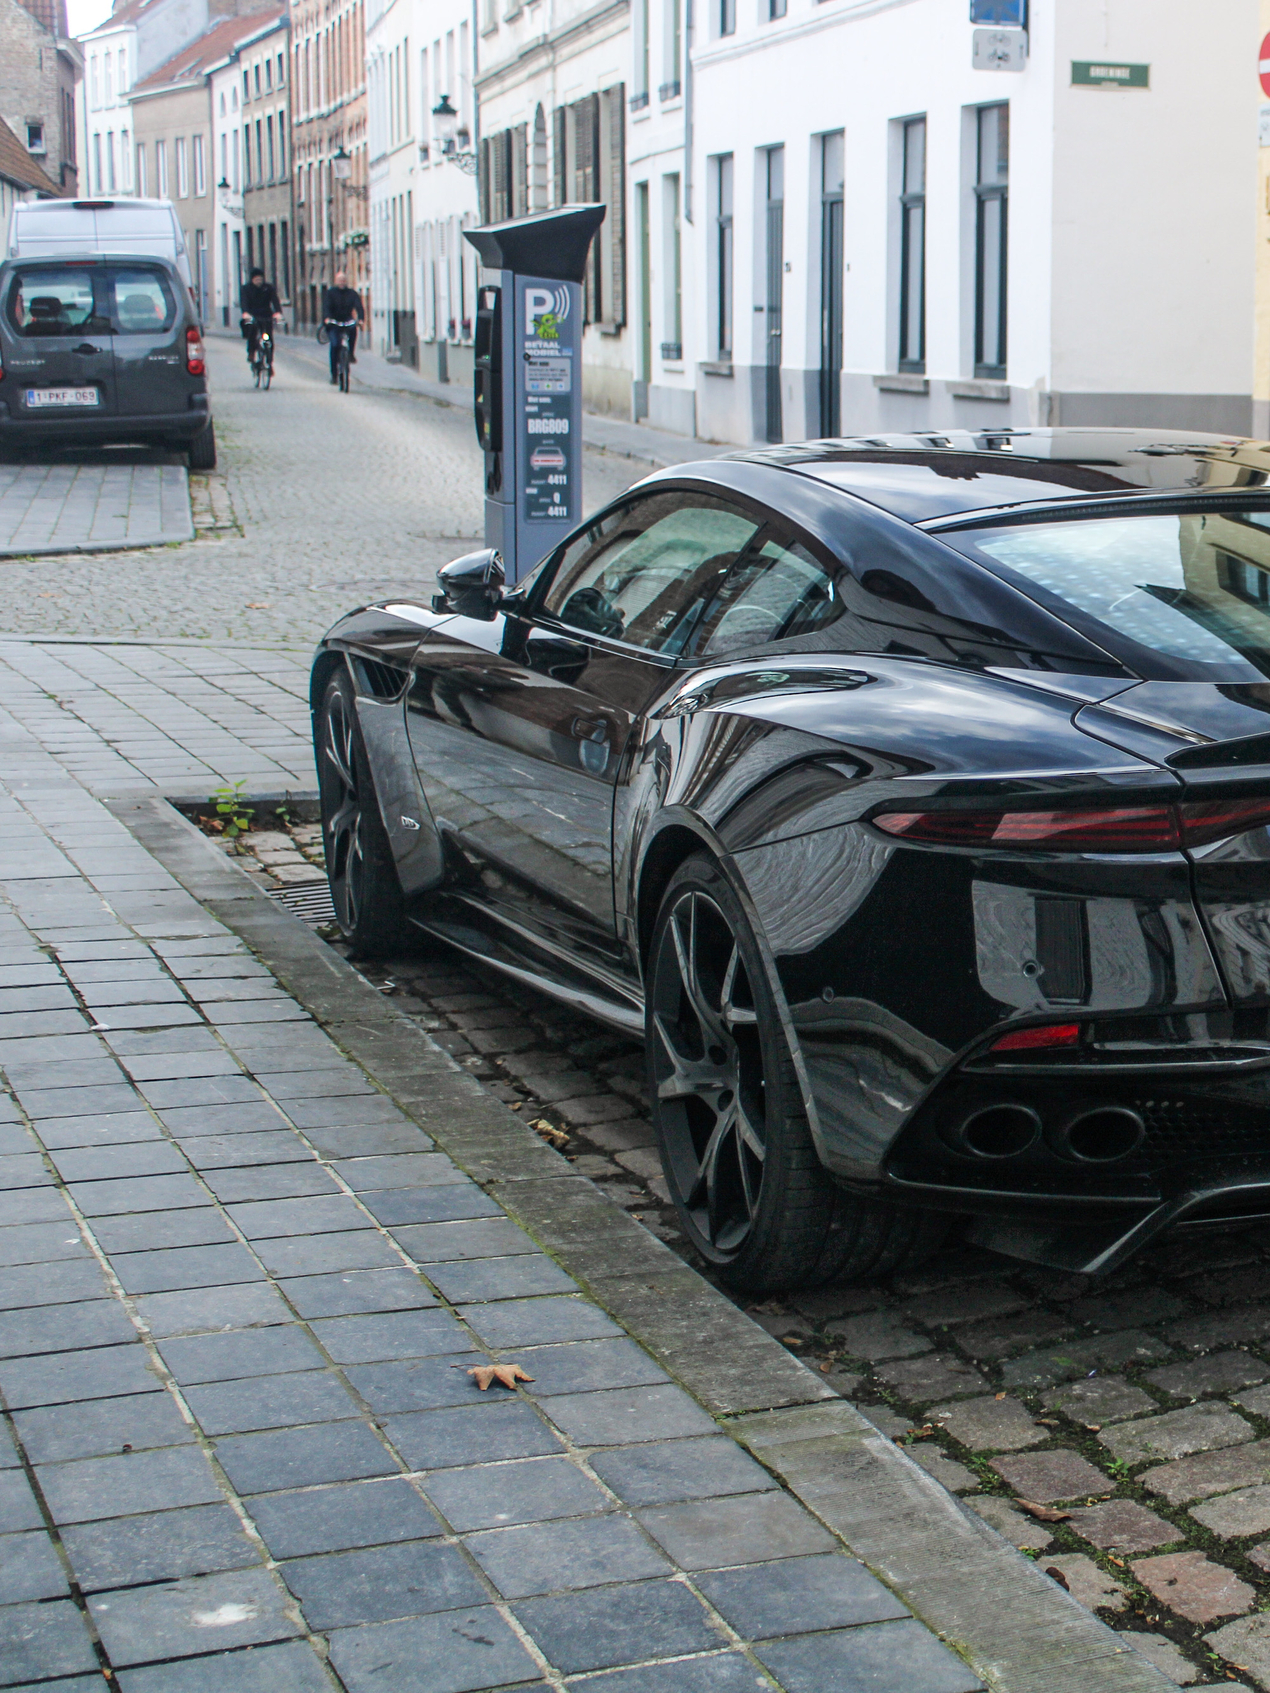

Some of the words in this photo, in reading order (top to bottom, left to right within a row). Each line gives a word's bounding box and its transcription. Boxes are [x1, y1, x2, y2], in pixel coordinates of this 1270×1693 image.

[525, 288, 555, 335] P
[524, 341, 560, 349] BETAAL
[528, 418, 569, 434] BRG809
[547, 474, 567, 485] 4411
[547, 506, 567, 517] 4411
